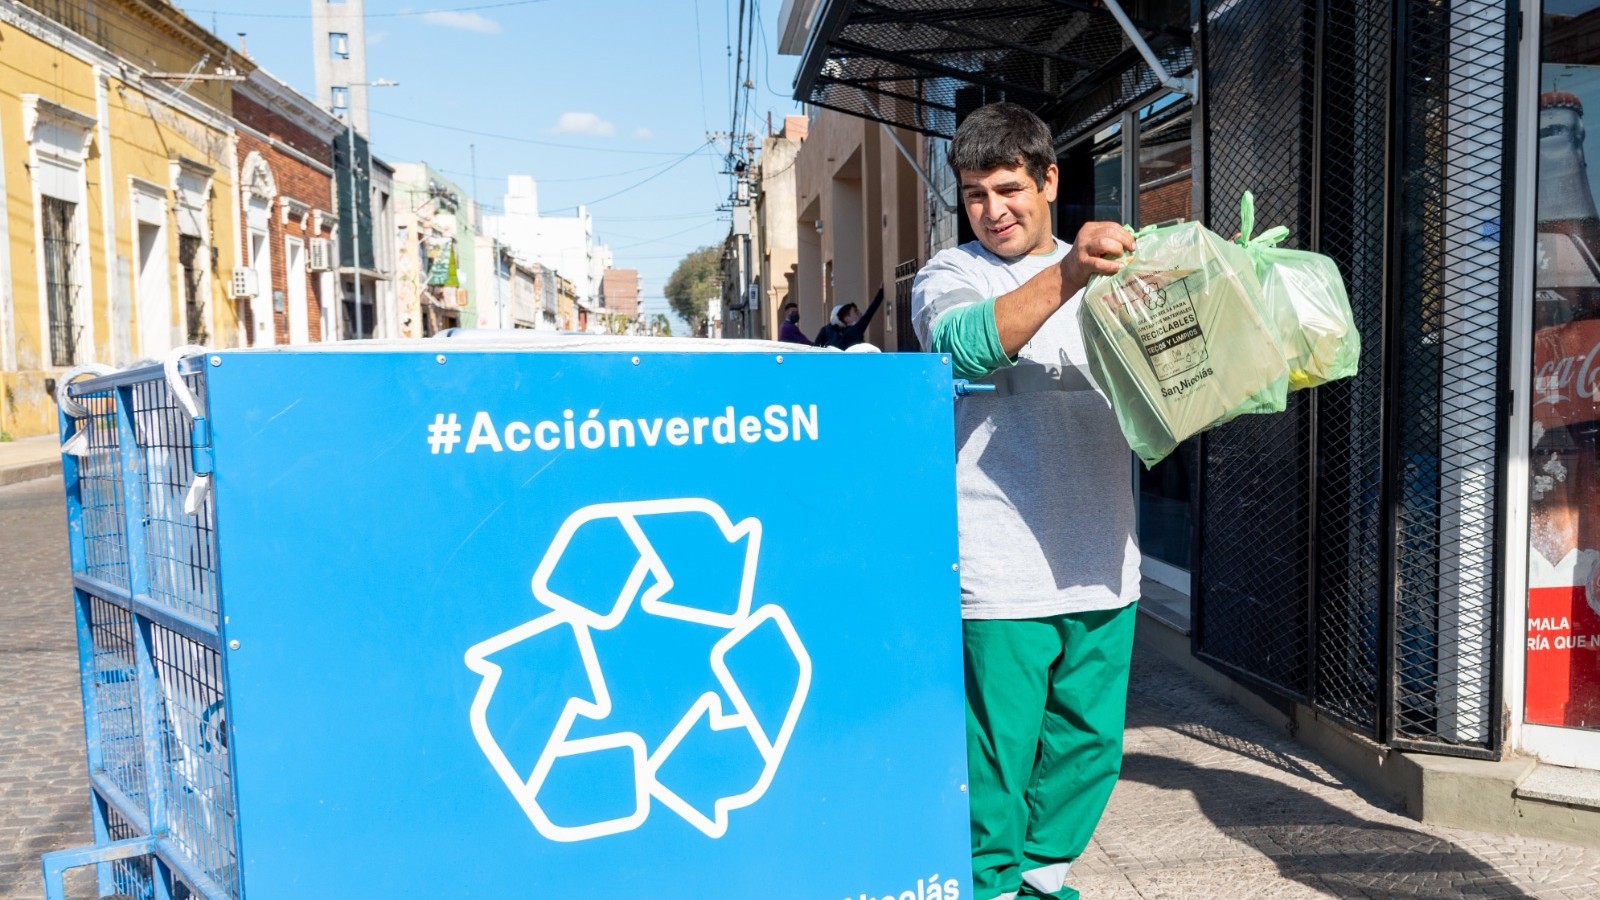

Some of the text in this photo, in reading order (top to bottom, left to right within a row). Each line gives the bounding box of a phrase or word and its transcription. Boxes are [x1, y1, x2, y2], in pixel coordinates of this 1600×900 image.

[1140, 314, 1195, 343] RECICLABLES
[1147, 328, 1198, 354] SECOS Y LIMPIOS
[1160, 386, 1183, 398] San
[1179, 367, 1214, 391] Nicolás
[427, 403, 819, 455] #AcciónverdeSN
[1554, 635, 1586, 650] QUE
